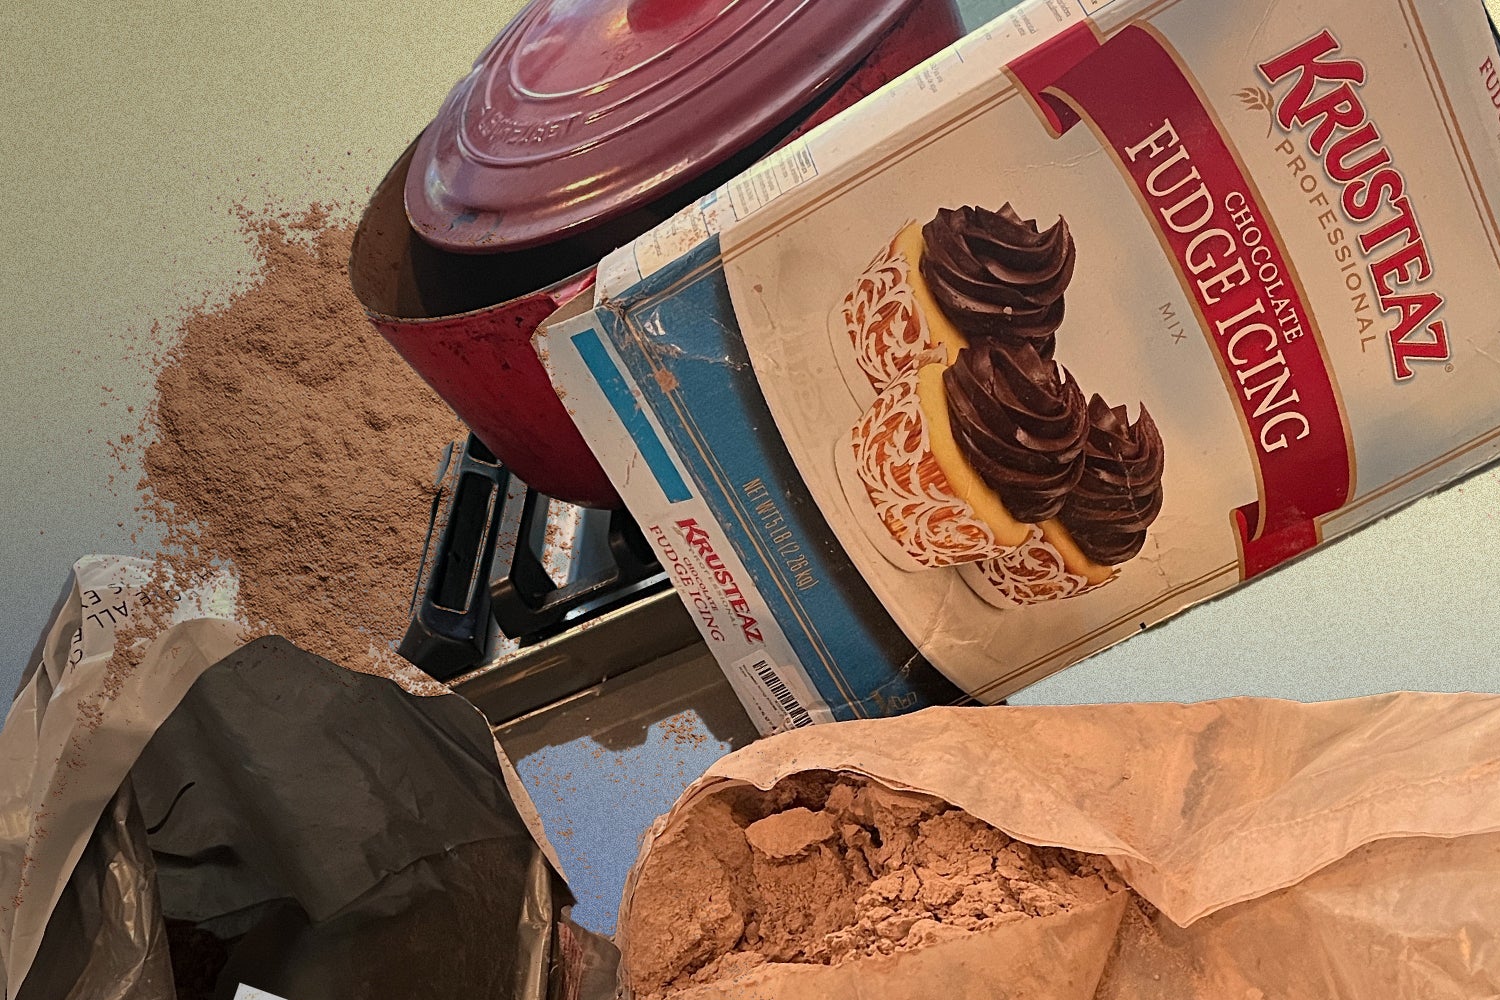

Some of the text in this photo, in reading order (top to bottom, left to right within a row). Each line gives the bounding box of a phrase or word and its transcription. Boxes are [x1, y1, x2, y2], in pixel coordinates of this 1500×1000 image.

[1259, 29, 1451, 380] KRUSTEAZ
[1274, 139, 1380, 354] PROFESSIONAL
[1124, 118, 1310, 453] FUDGE ICING
[1223, 190, 1304, 345] CHOCOLATE
[1158, 302, 1188, 346] MIX
[742, 478, 769, 503] NET
[755, 499, 781, 521] WT
[764, 516, 784, 530] 5
[769, 525, 793, 545] LB
[649, 525, 726, 642] FUDGE ICING
[675, 518, 764, 645] KRUSTEAZ
[683, 556, 719, 612] CHOCOLATE
